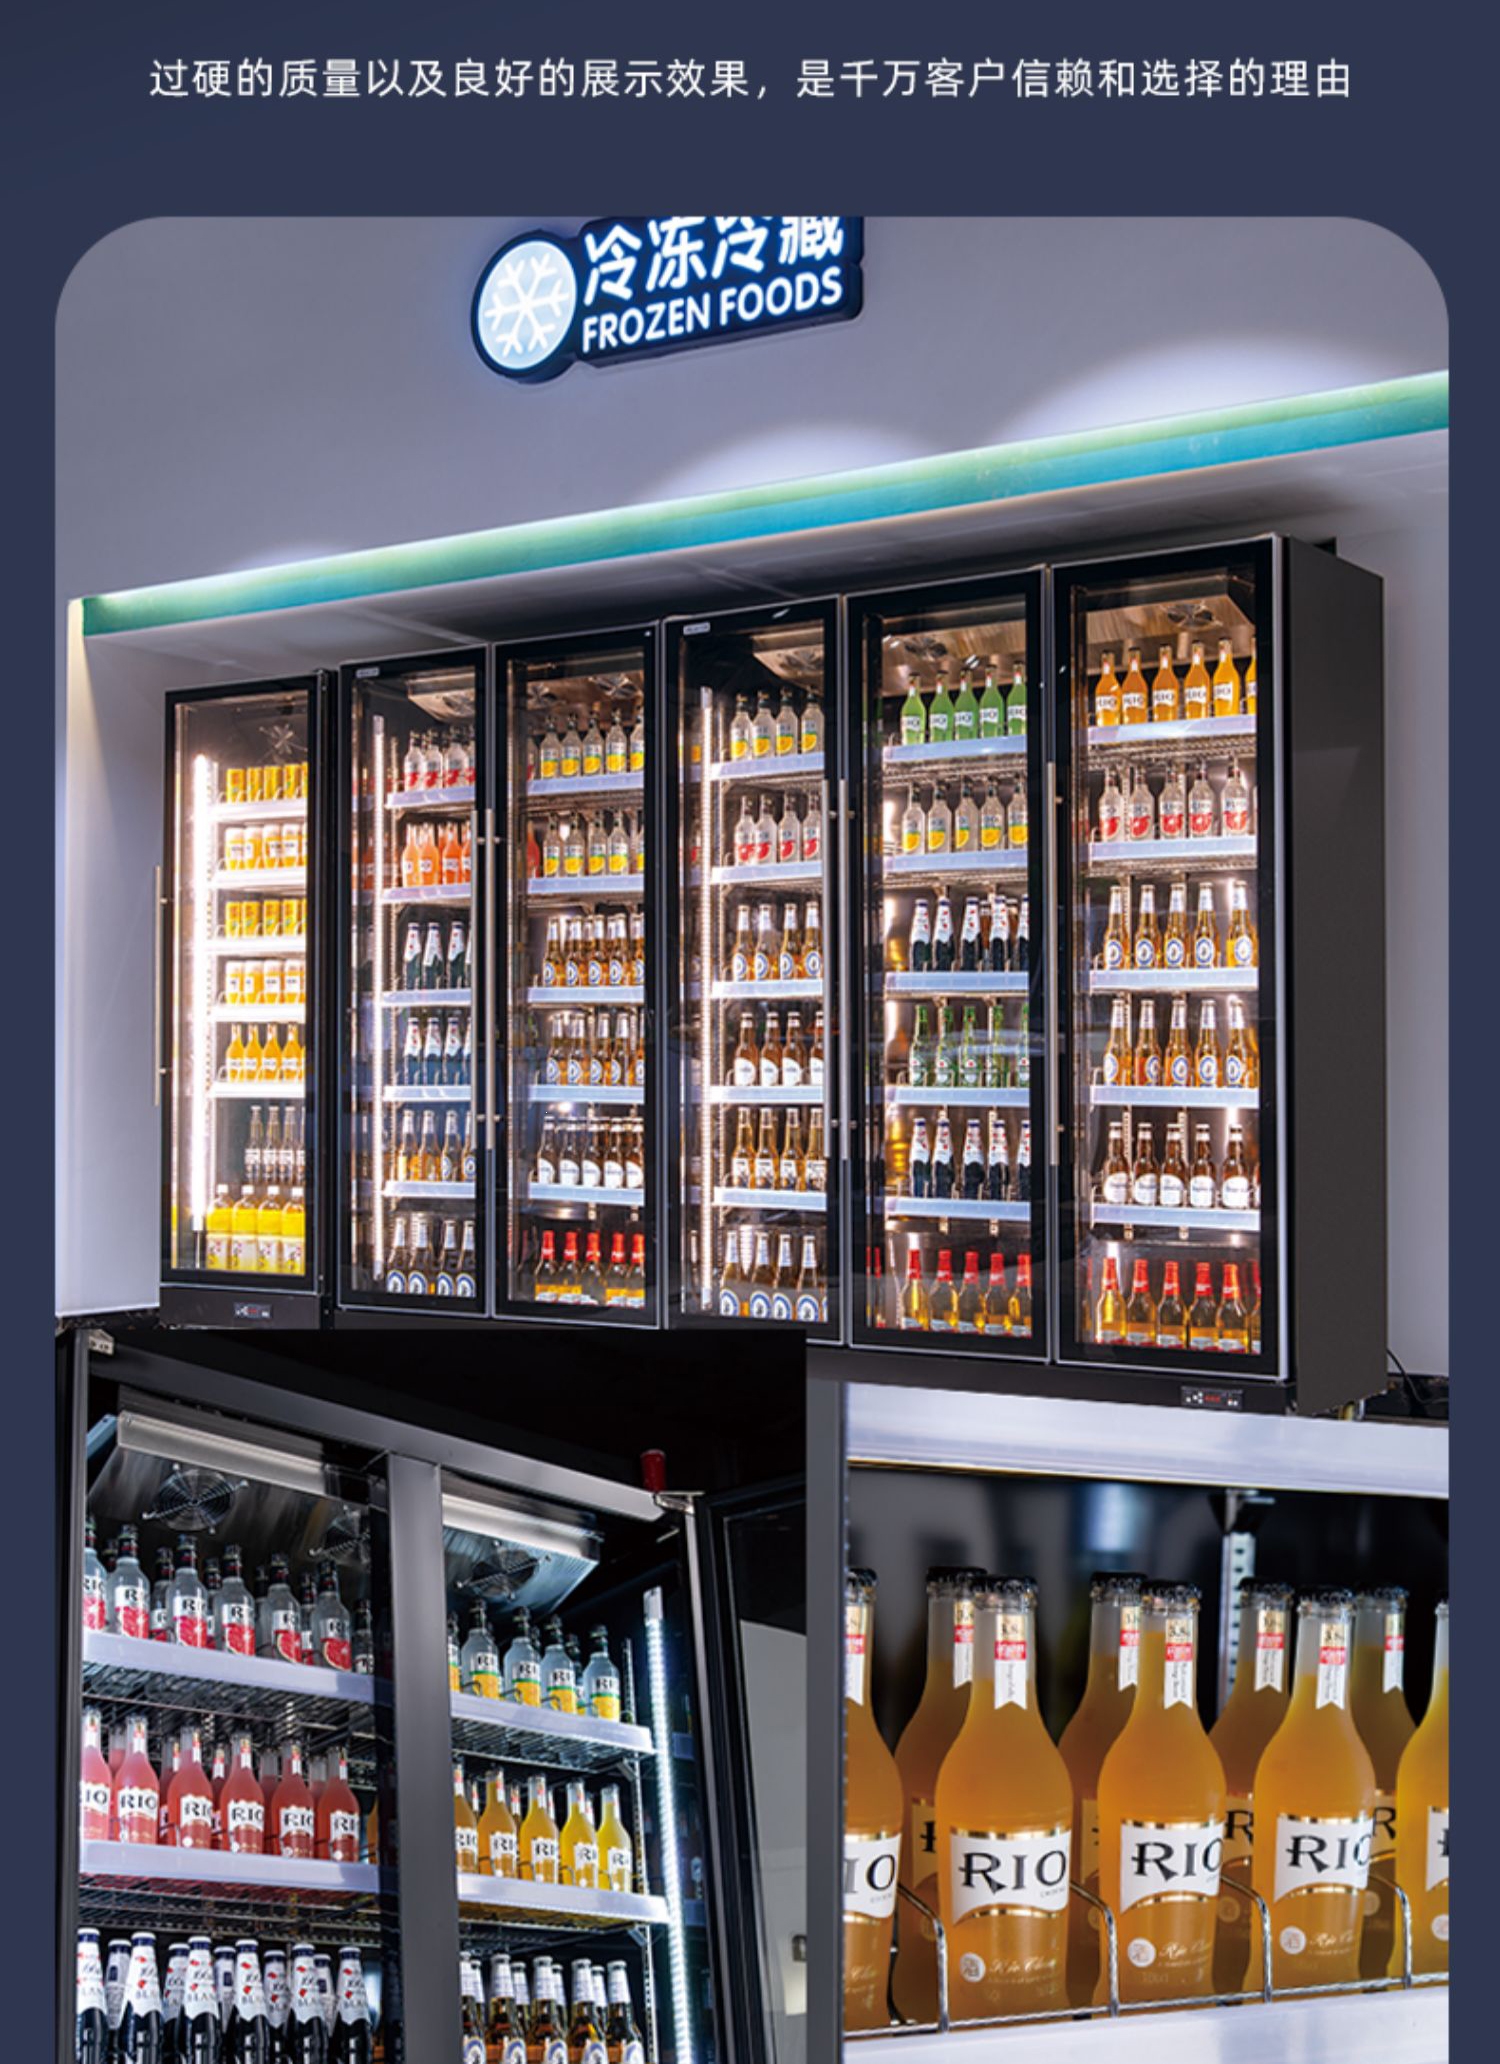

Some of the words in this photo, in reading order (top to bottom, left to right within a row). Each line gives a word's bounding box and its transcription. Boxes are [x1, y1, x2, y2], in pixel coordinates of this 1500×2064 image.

[582, 293, 711, 354] FROZEN
[720, 266, 844, 327] FOODS
[120, 1793, 158, 1810] RIO
[958, 1850, 1067, 1894] RIO
[1131, 1837, 1223, 1881] RIO
[1286, 1833, 1372, 1873] RIO
